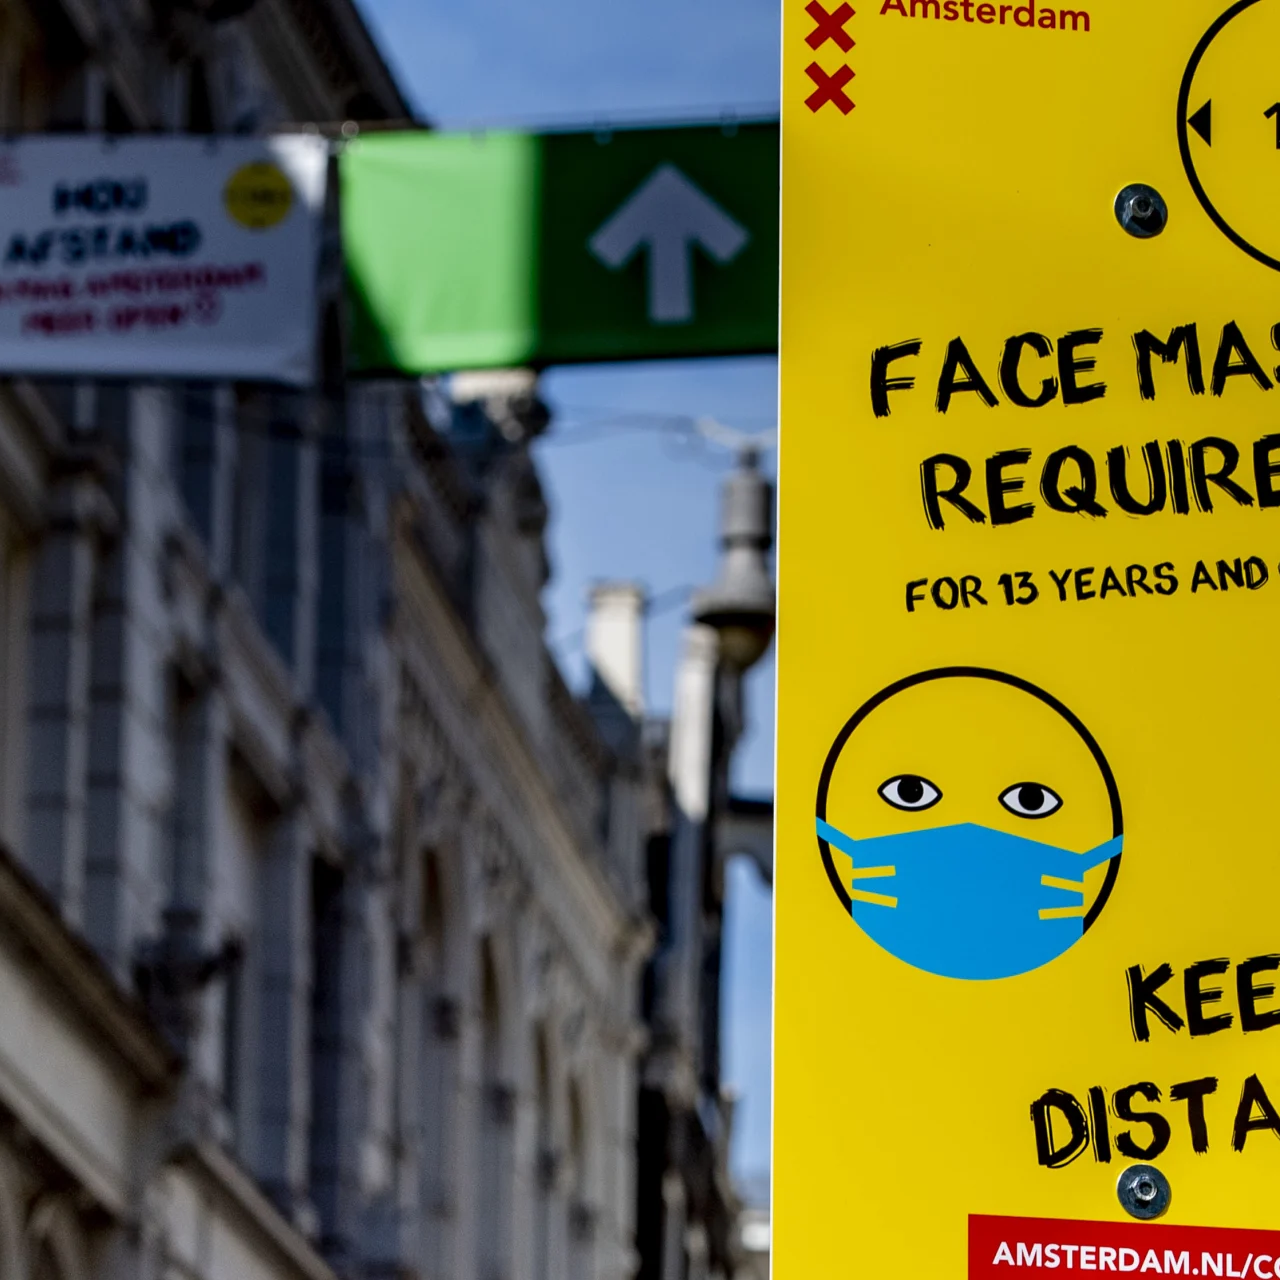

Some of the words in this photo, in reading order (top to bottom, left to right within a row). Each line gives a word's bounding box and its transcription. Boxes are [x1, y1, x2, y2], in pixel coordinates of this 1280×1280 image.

[880, 0, 1091, 32] Amsterdam
[868, 326, 1108, 418] FACE
[904, 575, 989, 613] FOR
[996, 570, 1040, 606] 13
[1048, 562, 1179, 602] YEARS
[1190, 555, 1270, 594] AND
